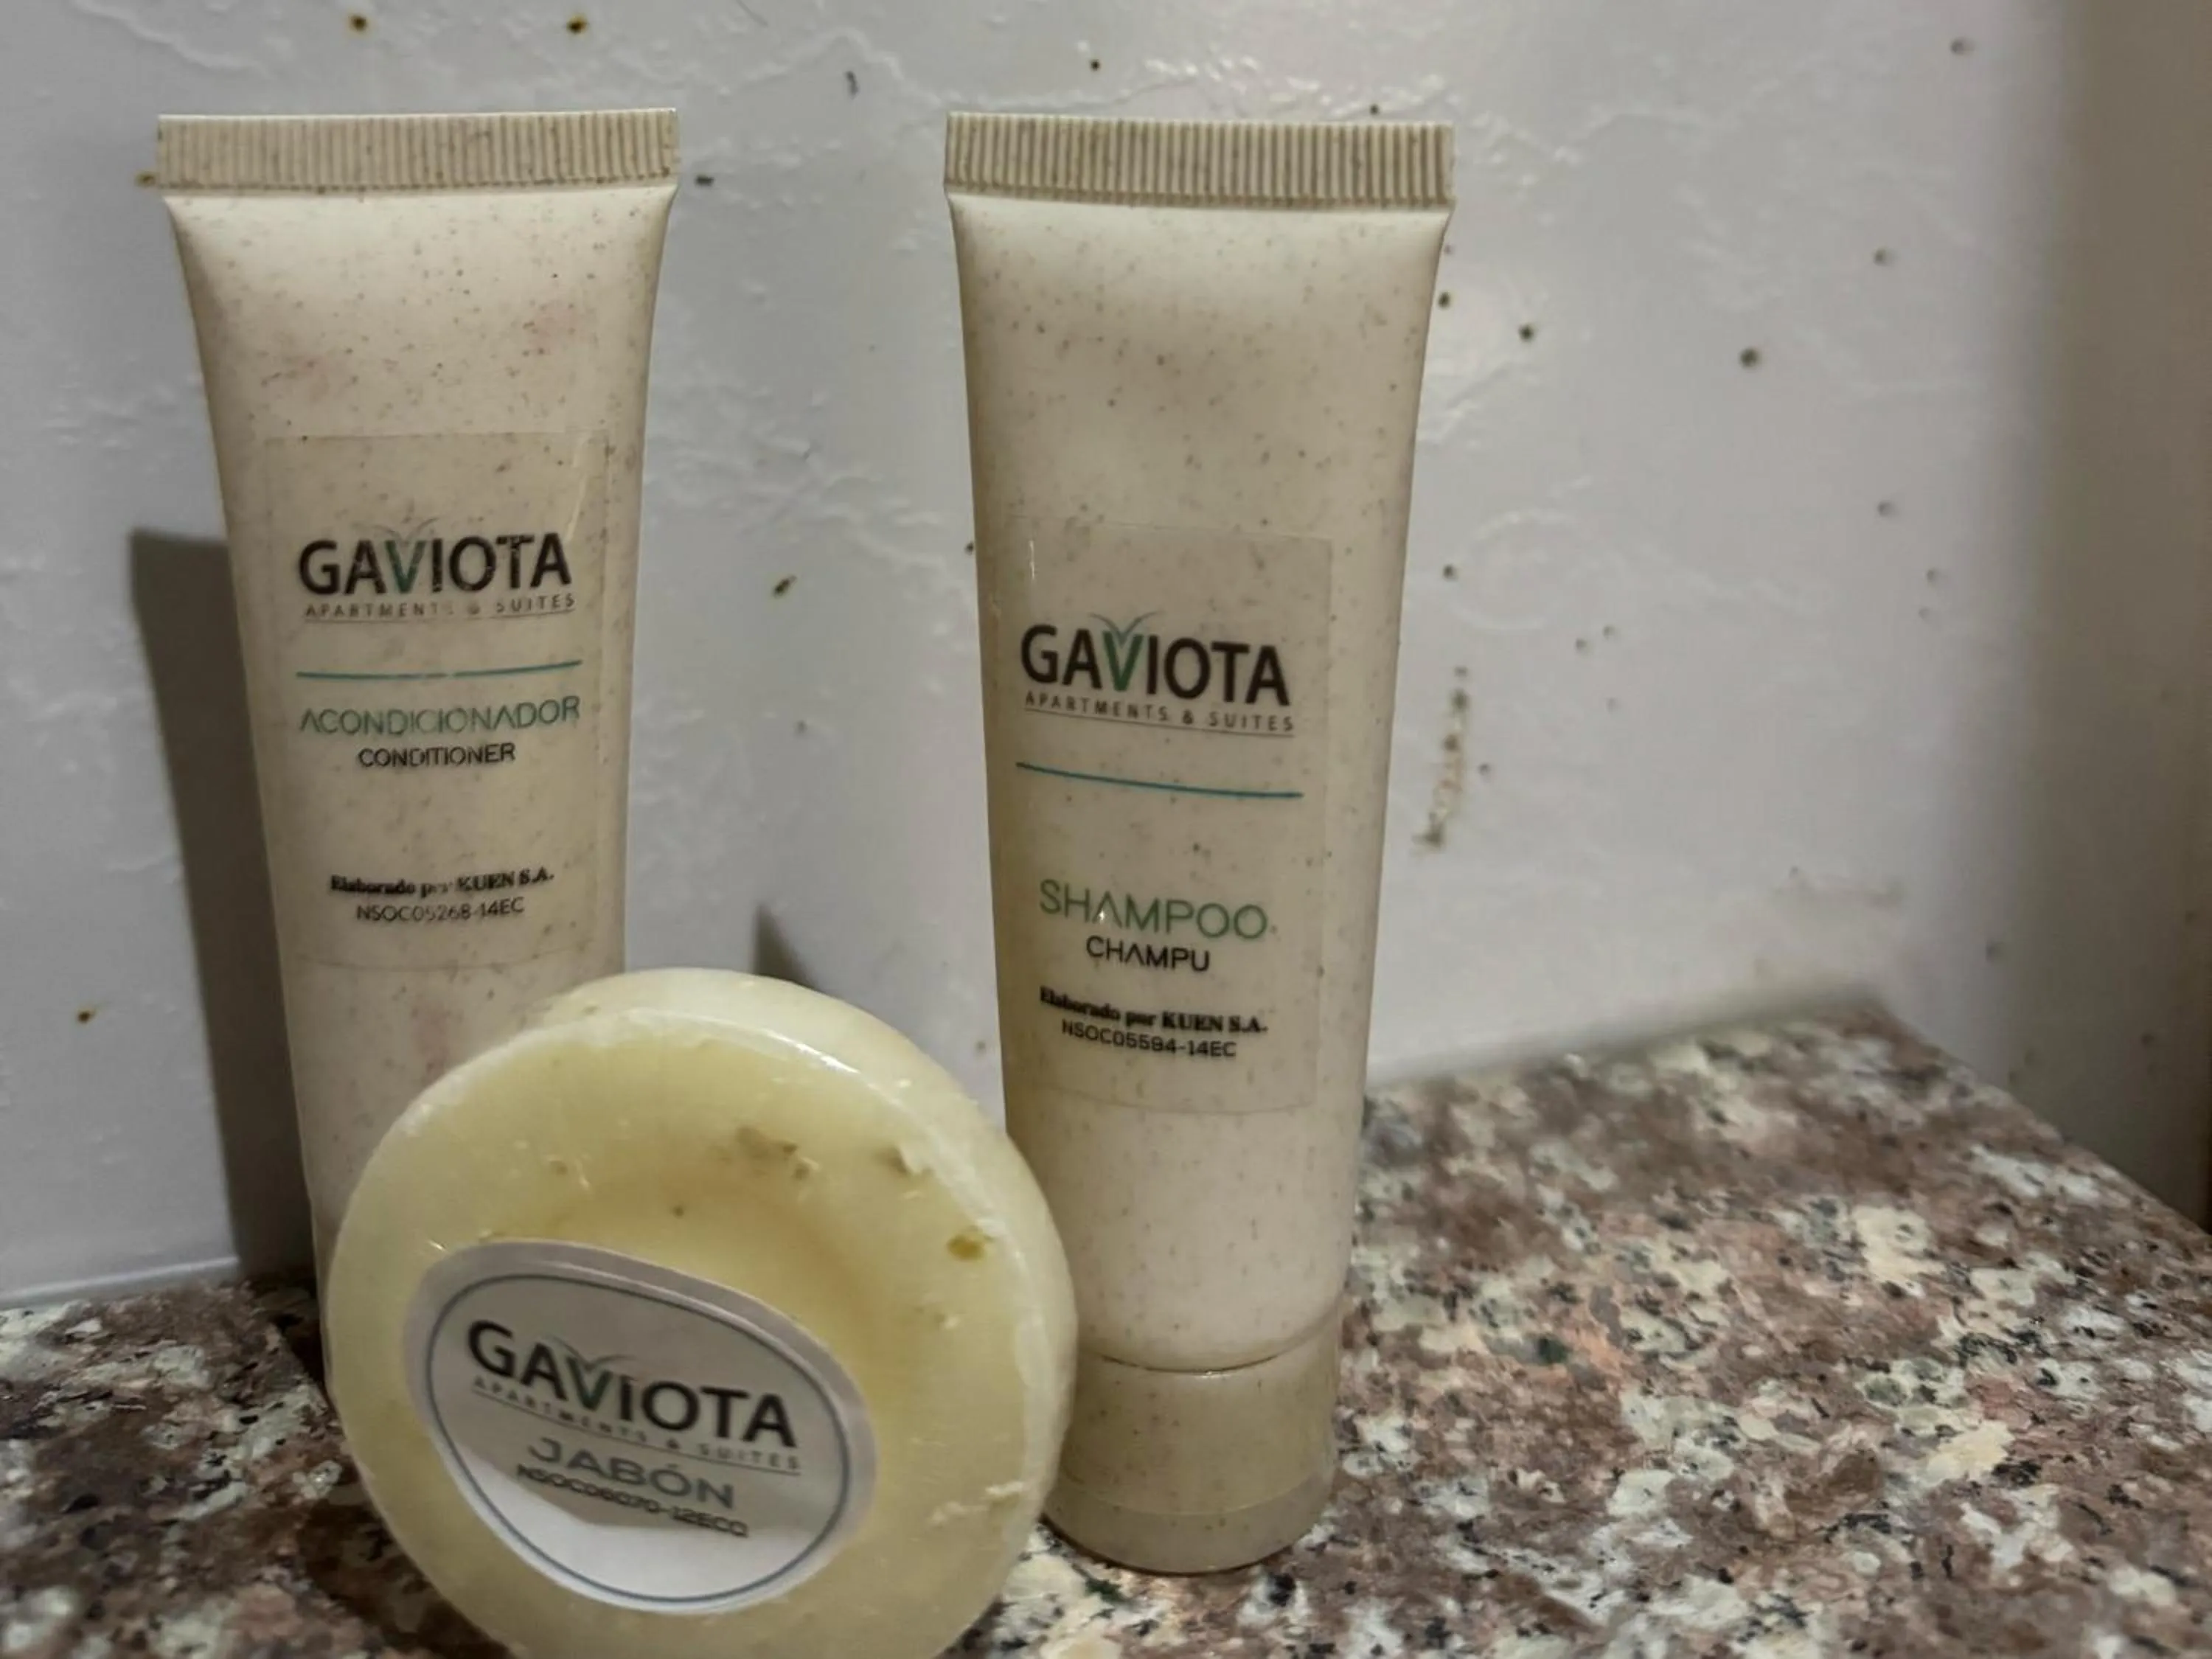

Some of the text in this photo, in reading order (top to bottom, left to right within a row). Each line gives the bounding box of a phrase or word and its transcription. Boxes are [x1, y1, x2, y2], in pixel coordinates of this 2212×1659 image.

[299, 532, 571, 595] GAVIOTA
[496, 592, 576, 614] SUITES
[1020, 624, 1290, 707] GAVIOTA
[299, 695, 580, 737] ACONDICIONADOR
[1025, 690, 1294, 732] APARTMENTS & SUITES
[357, 742, 516, 768] CONDITIONER
[330, 874, 417, 895] Elaborado
[1040, 878, 1268, 940] SHAMPOO
[1085, 935, 1210, 973] CHAMPU
[1039, 985, 1121, 1021] Elaborado
[1125, 1011, 1157, 1028] por
[1161, 1010, 1222, 1032] KUEN
[467, 1320, 797, 1449] GAVIOTA
[474, 1375, 647, 1443] APARTMENTS
[698, 1442, 801, 1470] SUITES
[527, 1437, 734, 1510] JABÓN
